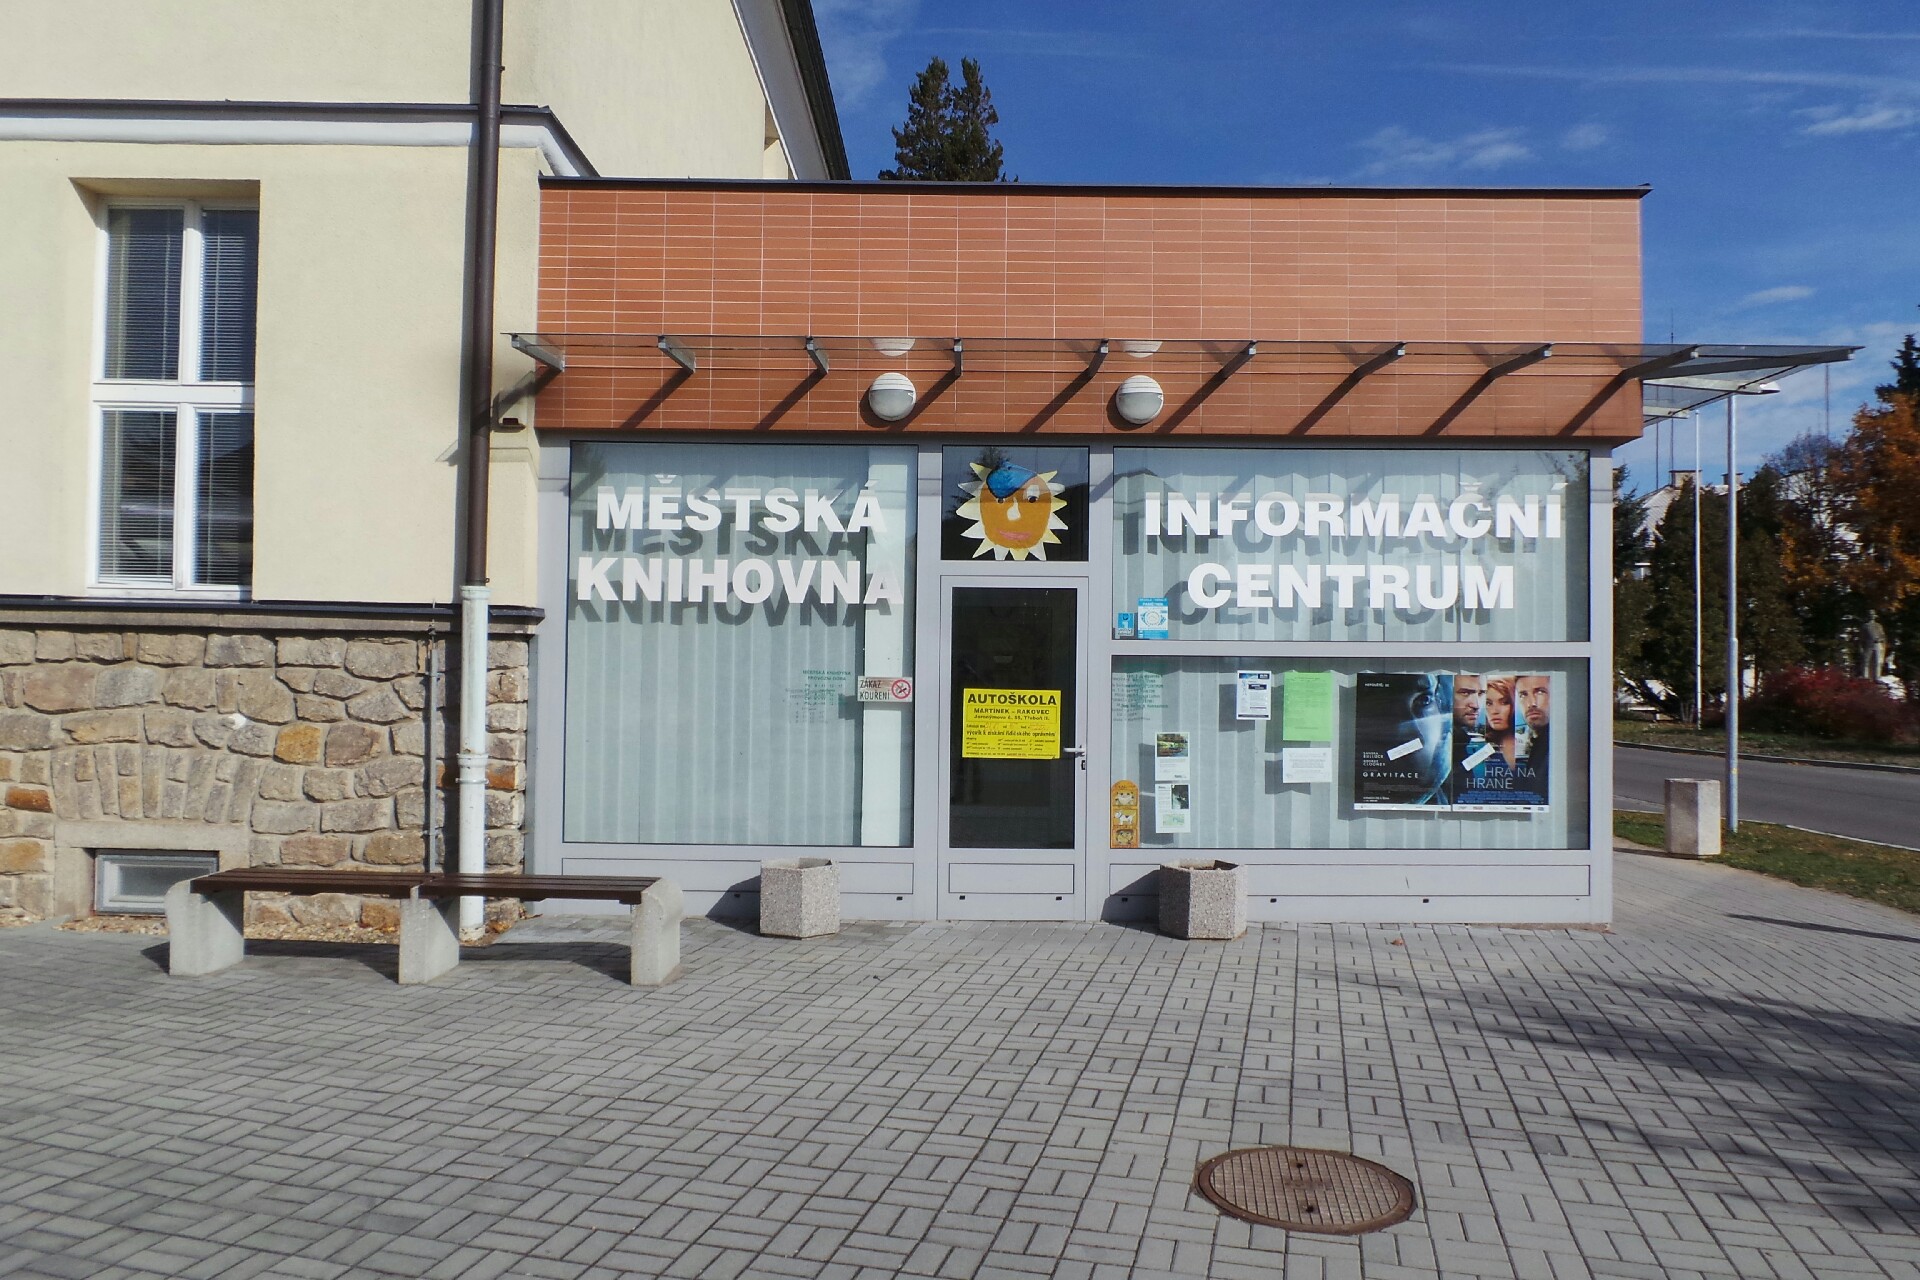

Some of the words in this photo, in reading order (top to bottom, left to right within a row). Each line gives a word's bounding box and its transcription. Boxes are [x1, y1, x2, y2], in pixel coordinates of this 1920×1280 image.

[596, 475, 887, 533] MĚSTSKÁ
[1144, 482, 1569, 539] INFORMAČNÍ
[577, 556, 904, 605] KNIHOVNA
[1187, 562, 1515, 610] CENTRUM
[860, 677, 882, 689] ZÁKAZ
[860, 689, 890, 701] KOUŘENÍ
[967, 691, 1057, 706] AUTOŠKOLA
[1362, 771, 1419, 779] GRAVITACE
[1484, 766, 1514, 778] HRA
[1517, 766, 1536, 778] NA
